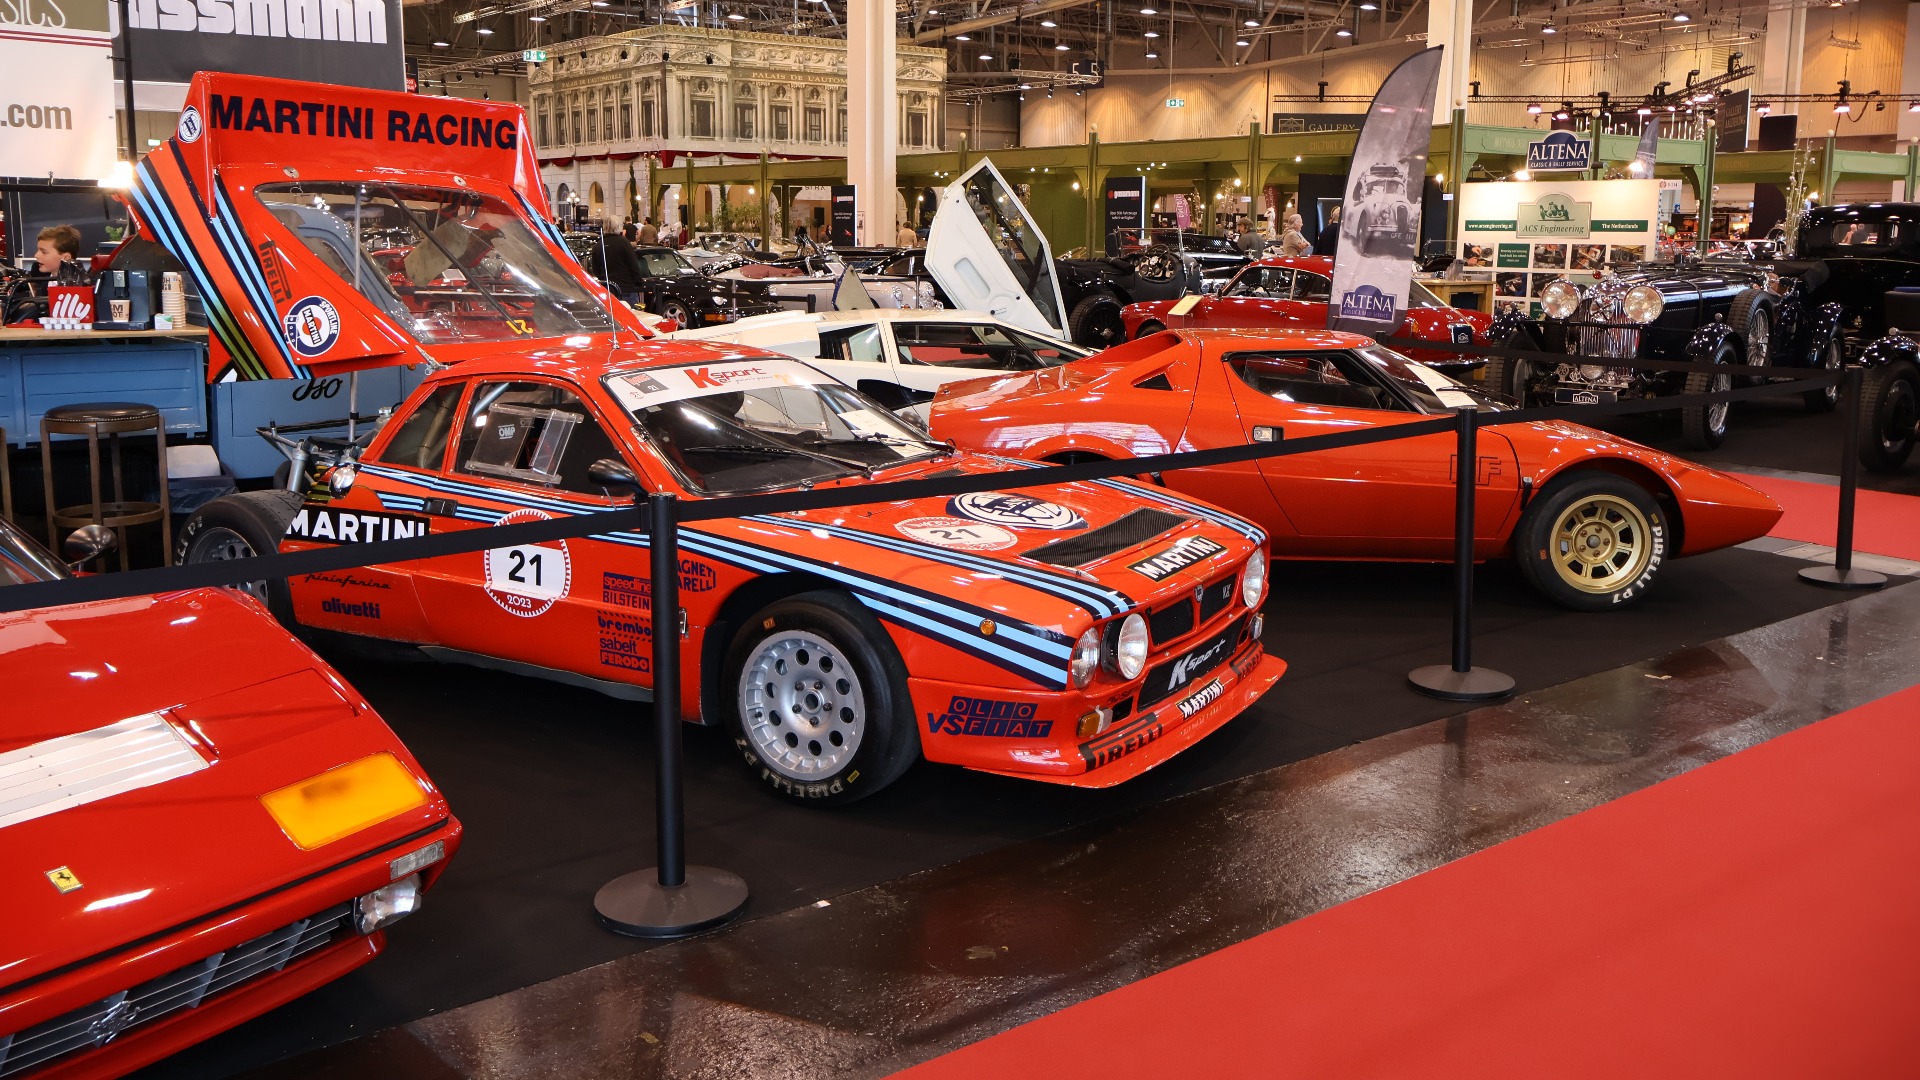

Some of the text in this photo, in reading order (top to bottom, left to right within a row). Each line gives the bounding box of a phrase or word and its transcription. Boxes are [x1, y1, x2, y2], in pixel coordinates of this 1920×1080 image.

[110, 0, 388, 44] assmann
[752, 72, 786, 80] PALAIS
[211, 94, 374, 140] MARTINI
[387, 109, 518, 151] RACING
[1529, 142, 1588, 160] ALTENA
[1522, 224, 1585, 234] ACS Engineering
[258, 239, 292, 305] PIRELLI
[51, 292, 91, 320] illy
[1342, 293, 1392, 312] ALTENA
[302, 308, 322, 345] MARTINI
[319, 300, 338, 335] SPORTLINE
[683, 367, 767, 389] Ksport
[1573, 395, 1598, 403] ALTENA
[498, 426, 516, 437] OMP
[286, 508, 426, 544] MARTINI
[929, 528, 983, 541] 21
[507, 548, 543, 587] 21
[1133, 537, 1222, 579] MARTINI
[1611, 525, 1665, 605] PIRELLI P7
[303, 572, 392, 591] pininfarina
[603, 574, 652, 593] speedline
[321, 597, 381, 620] olivetti
[506, 593, 532, 609] 2023
[602, 590, 650, 611] BILSTEIN
[597, 615, 652, 637] brembo
[599, 636, 638, 655] sabelt
[601, 652, 649, 671] FERODO
[1167, 638, 1226, 691] Ksport
[952, 699, 1033, 720] OLIO
[1178, 679, 1225, 719] MARTINI
[926, 712, 1049, 736] VS FIAT
[1078, 712, 1163, 773] PIRELLI
